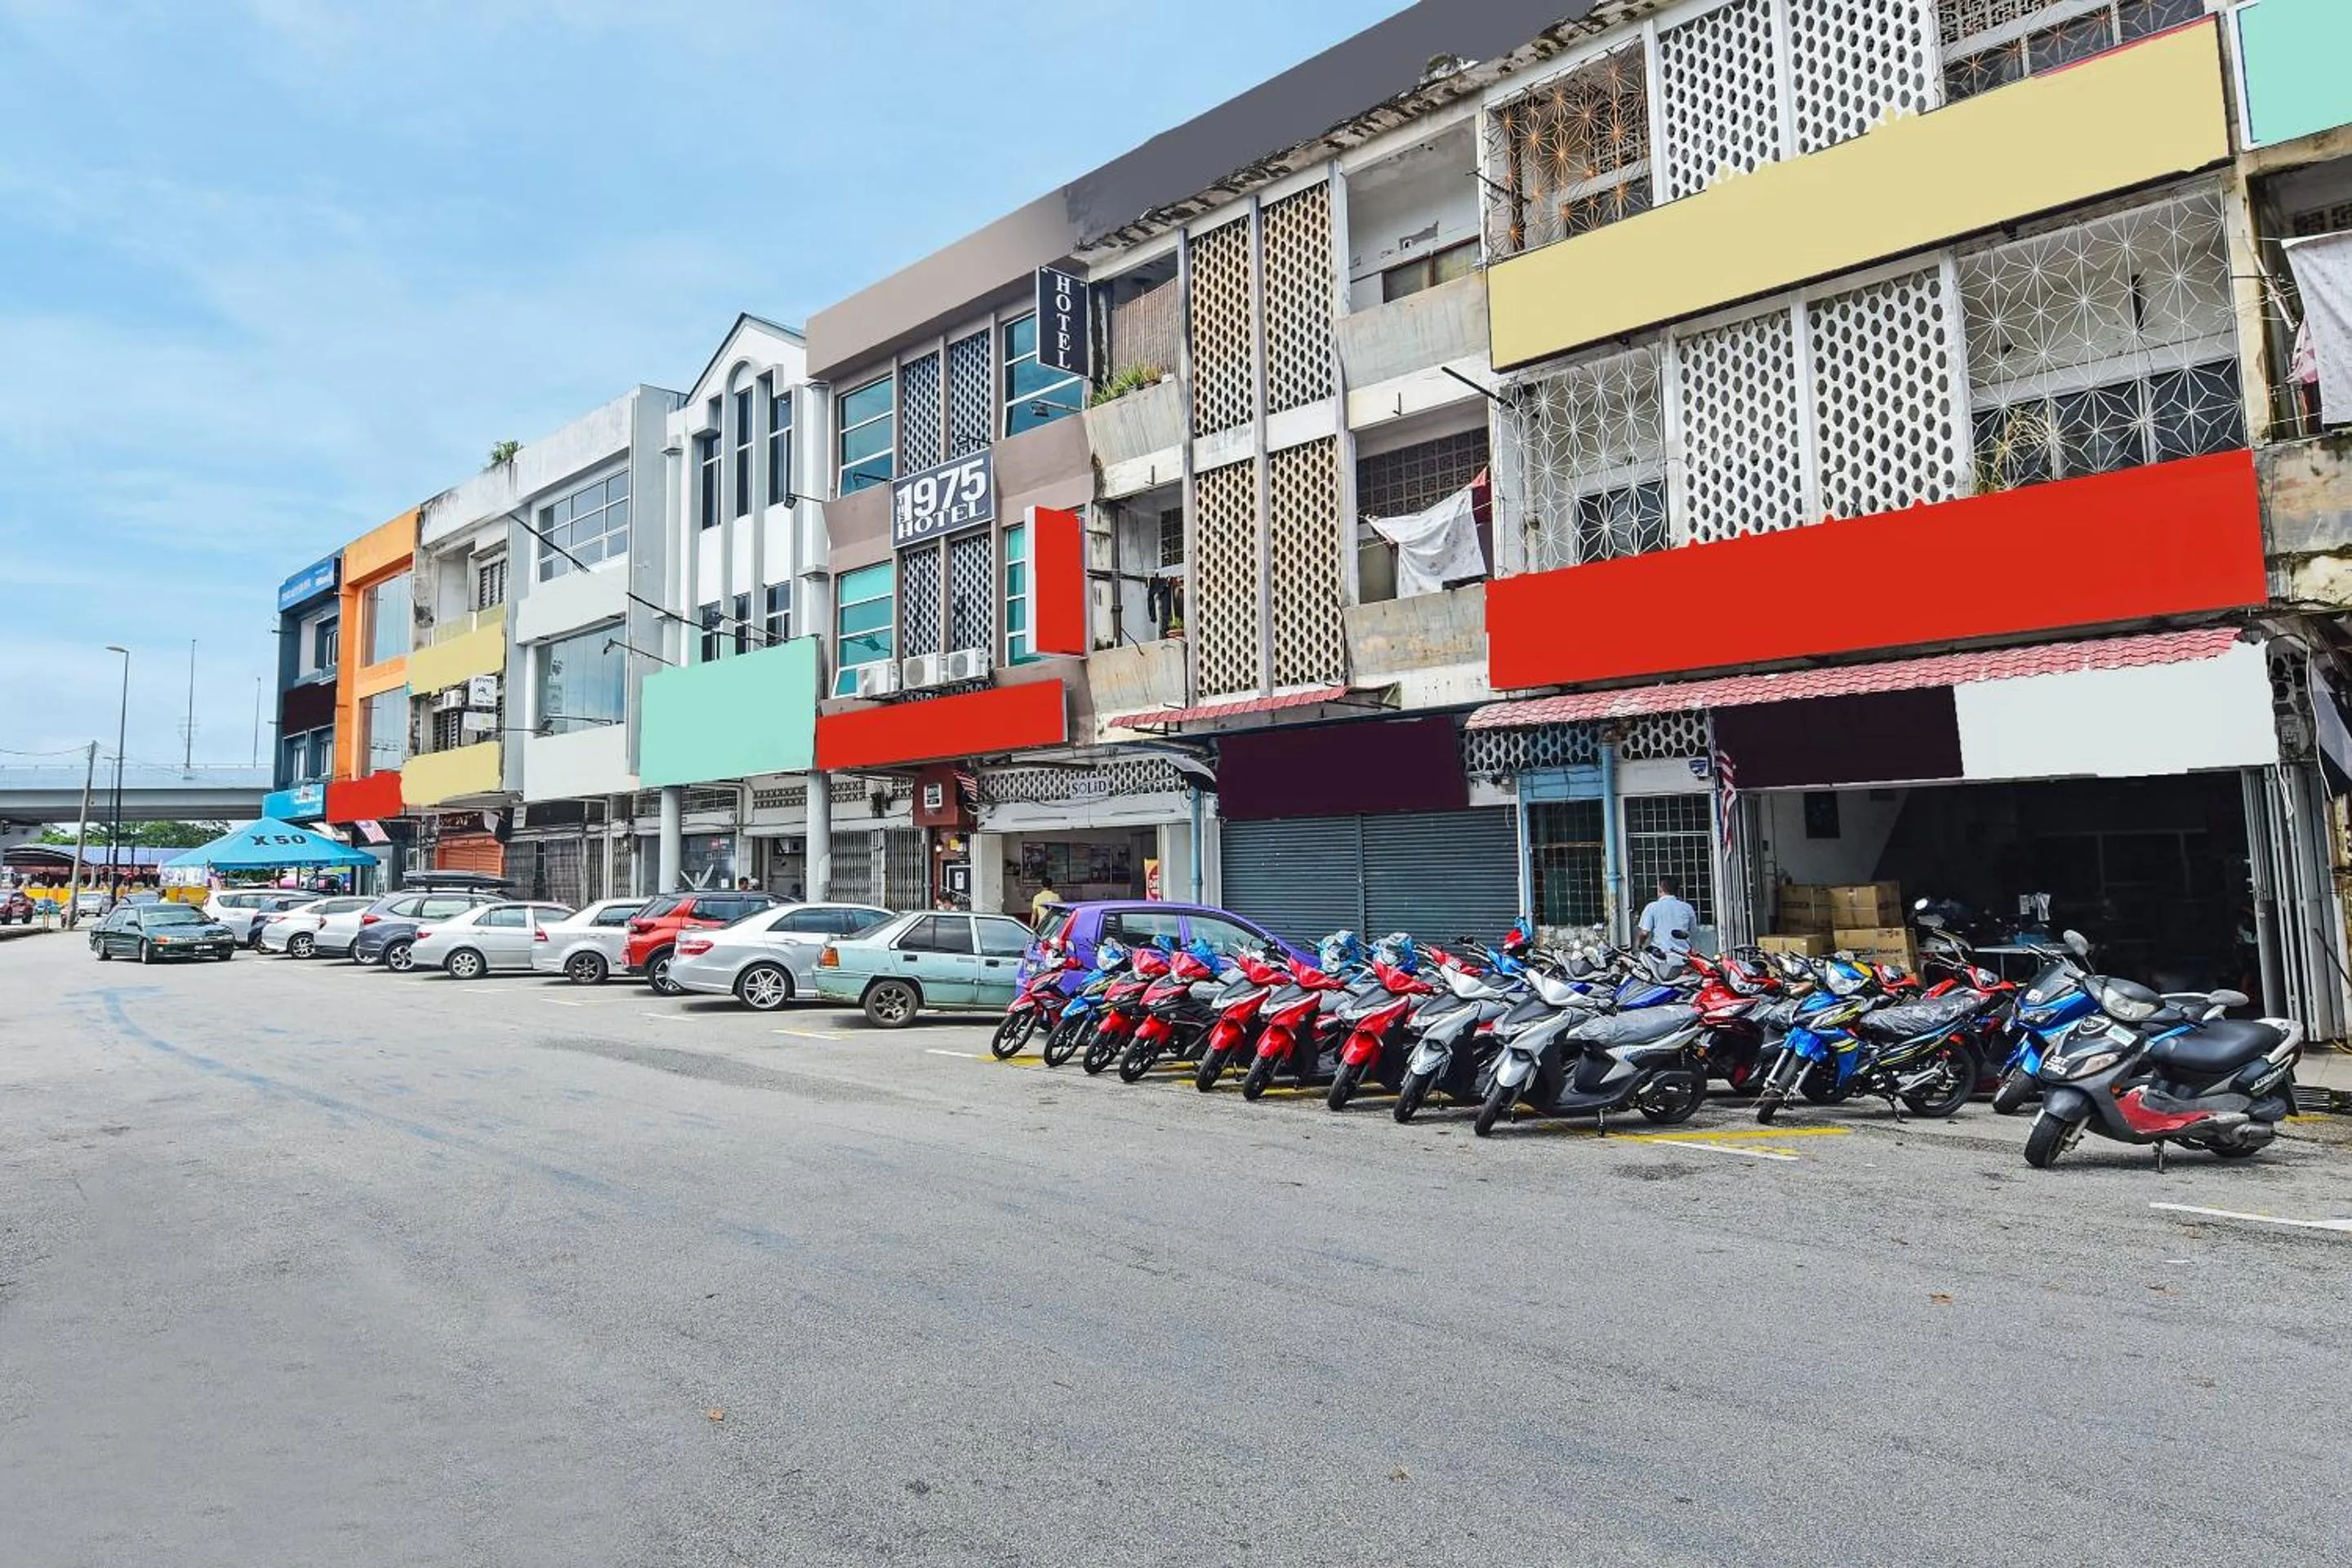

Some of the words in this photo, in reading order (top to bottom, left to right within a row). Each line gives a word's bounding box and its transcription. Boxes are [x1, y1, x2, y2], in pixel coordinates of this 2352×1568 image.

[1056, 274, 1071, 369] HOTEL
[896, 458, 987, 522] 1975
[897, 501, 986, 540] HOTEL
[250, 835, 270, 845] X
[274, 835, 306, 845] 50
